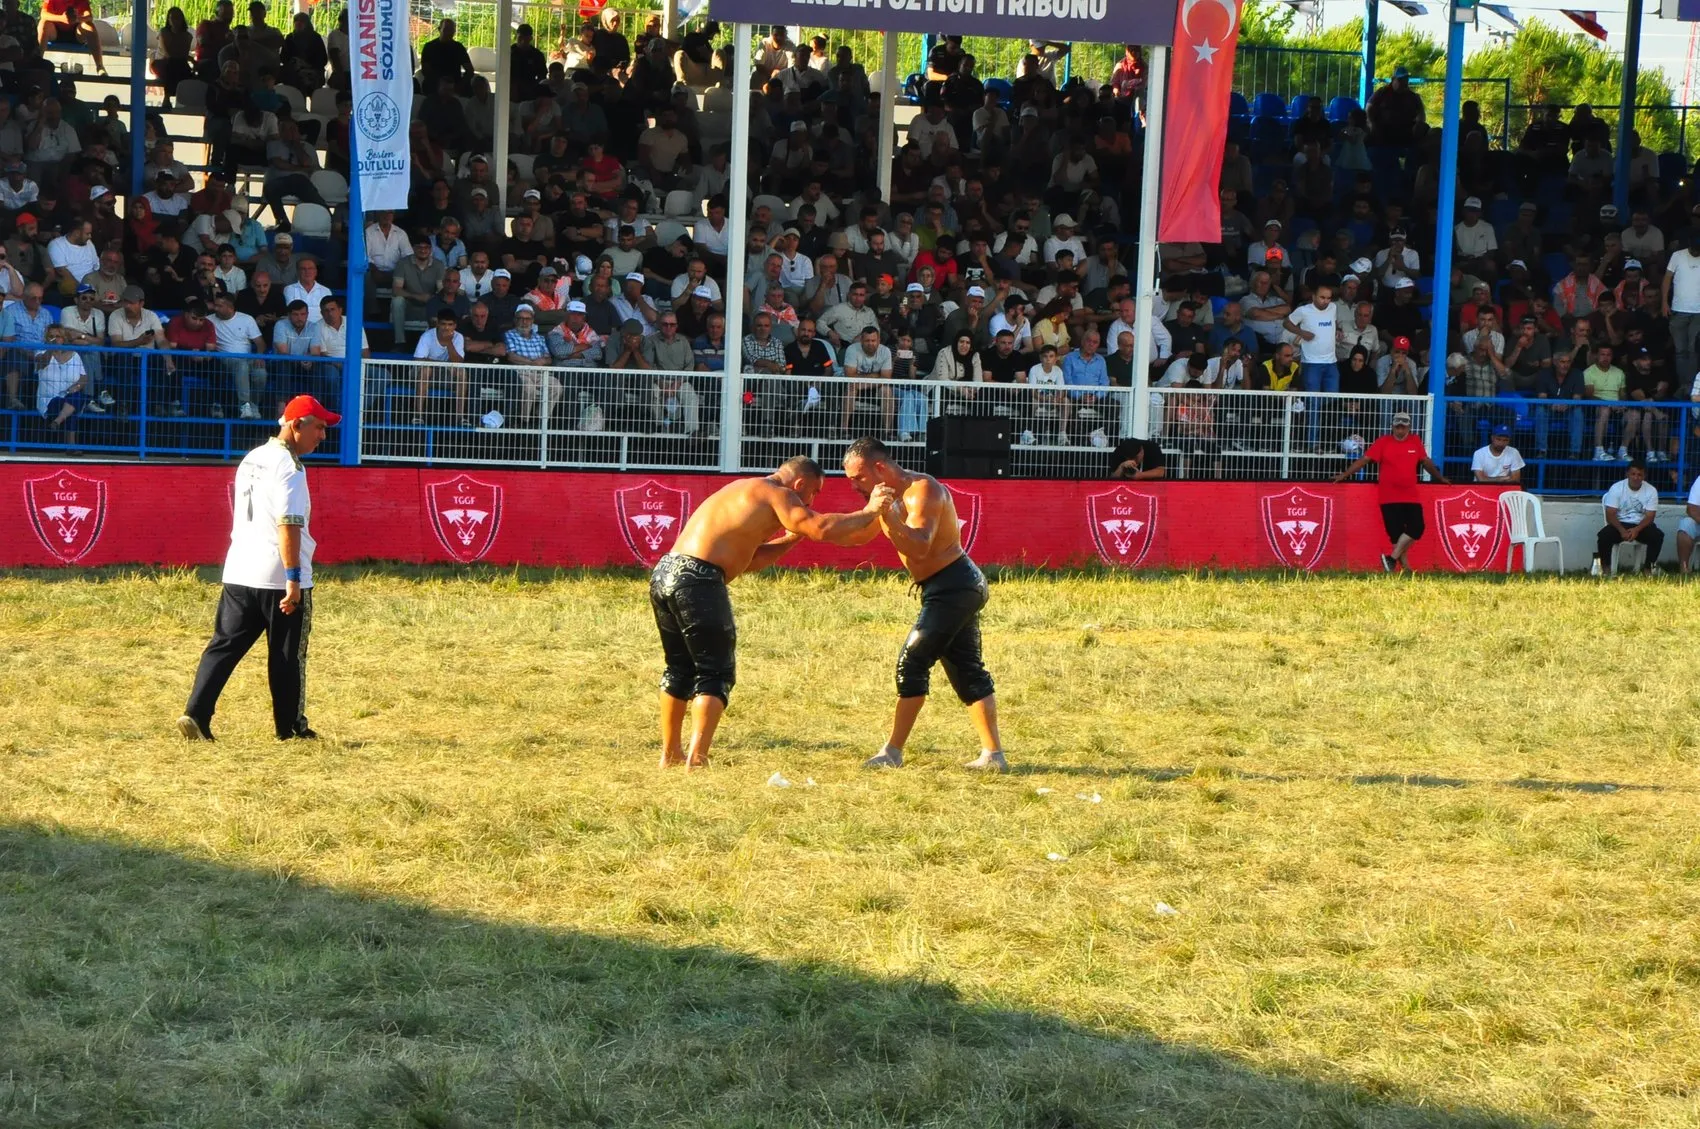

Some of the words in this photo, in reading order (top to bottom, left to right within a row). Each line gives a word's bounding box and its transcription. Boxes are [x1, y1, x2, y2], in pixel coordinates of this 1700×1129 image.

[365, 148, 396, 161] Besim
[52, 492, 78, 501] TGGF
[453, 496, 476, 505] TGGF
[642, 501, 664, 510] TGGF
[1112, 507, 1133, 515] TGGF
[1286, 507, 1307, 516] TGGF
